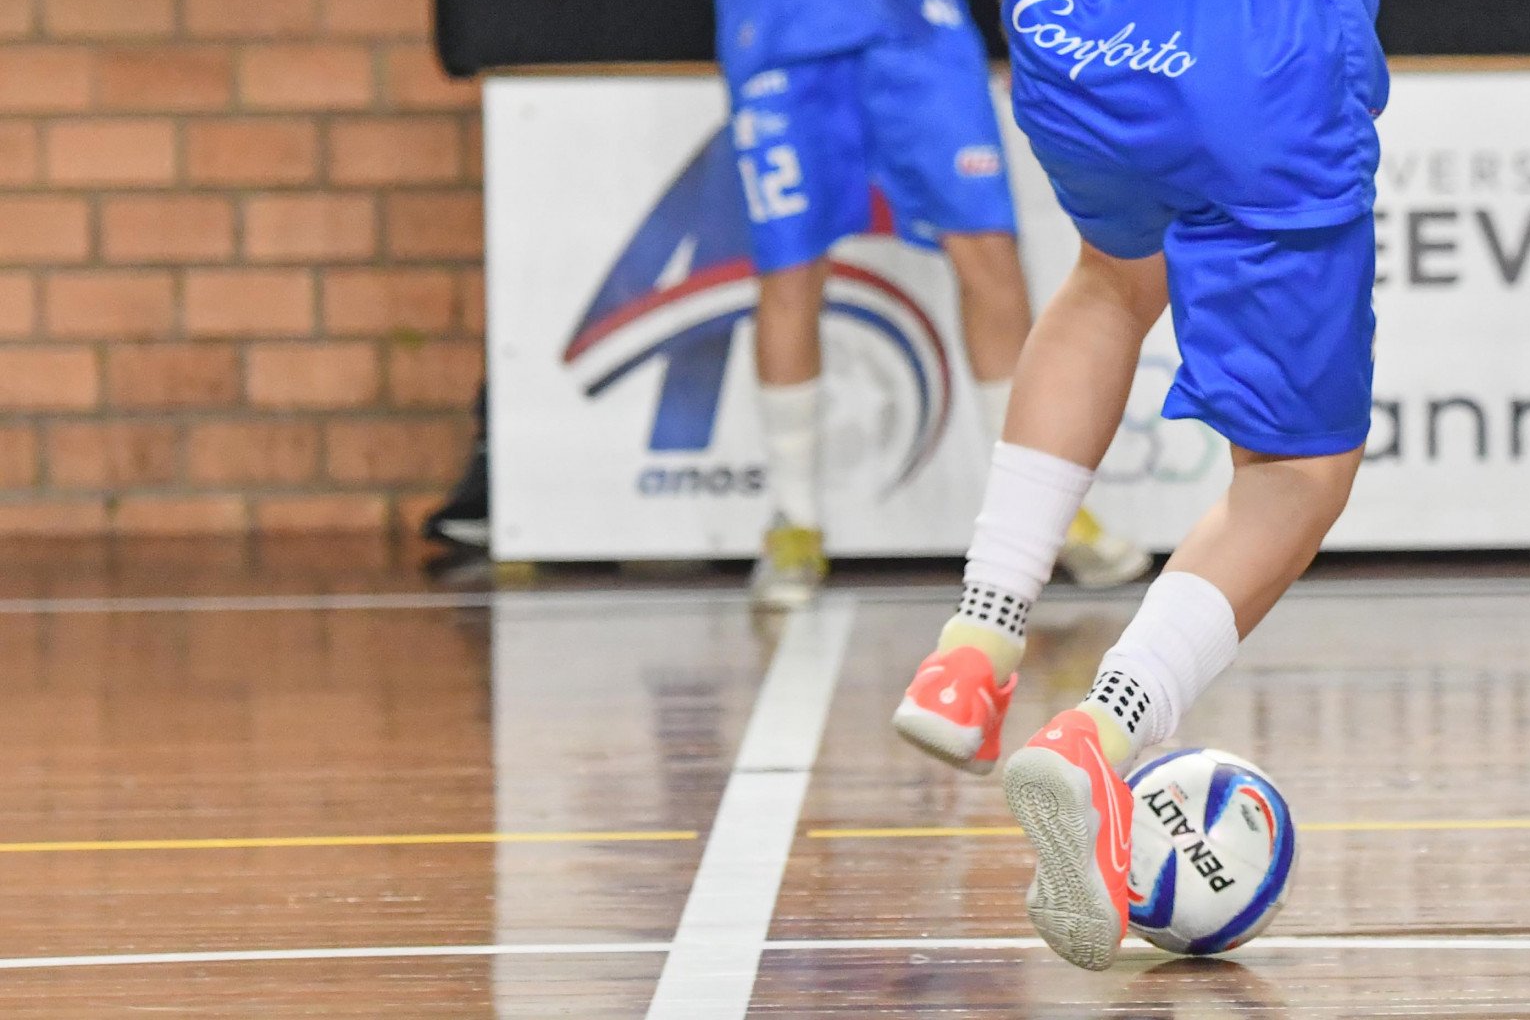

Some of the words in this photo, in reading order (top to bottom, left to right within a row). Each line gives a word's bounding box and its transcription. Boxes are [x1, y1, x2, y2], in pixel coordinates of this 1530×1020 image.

[737, 147, 809, 223] 12
[635, 465, 766, 496] anos
[1141, 787, 1236, 873] PENALTY
